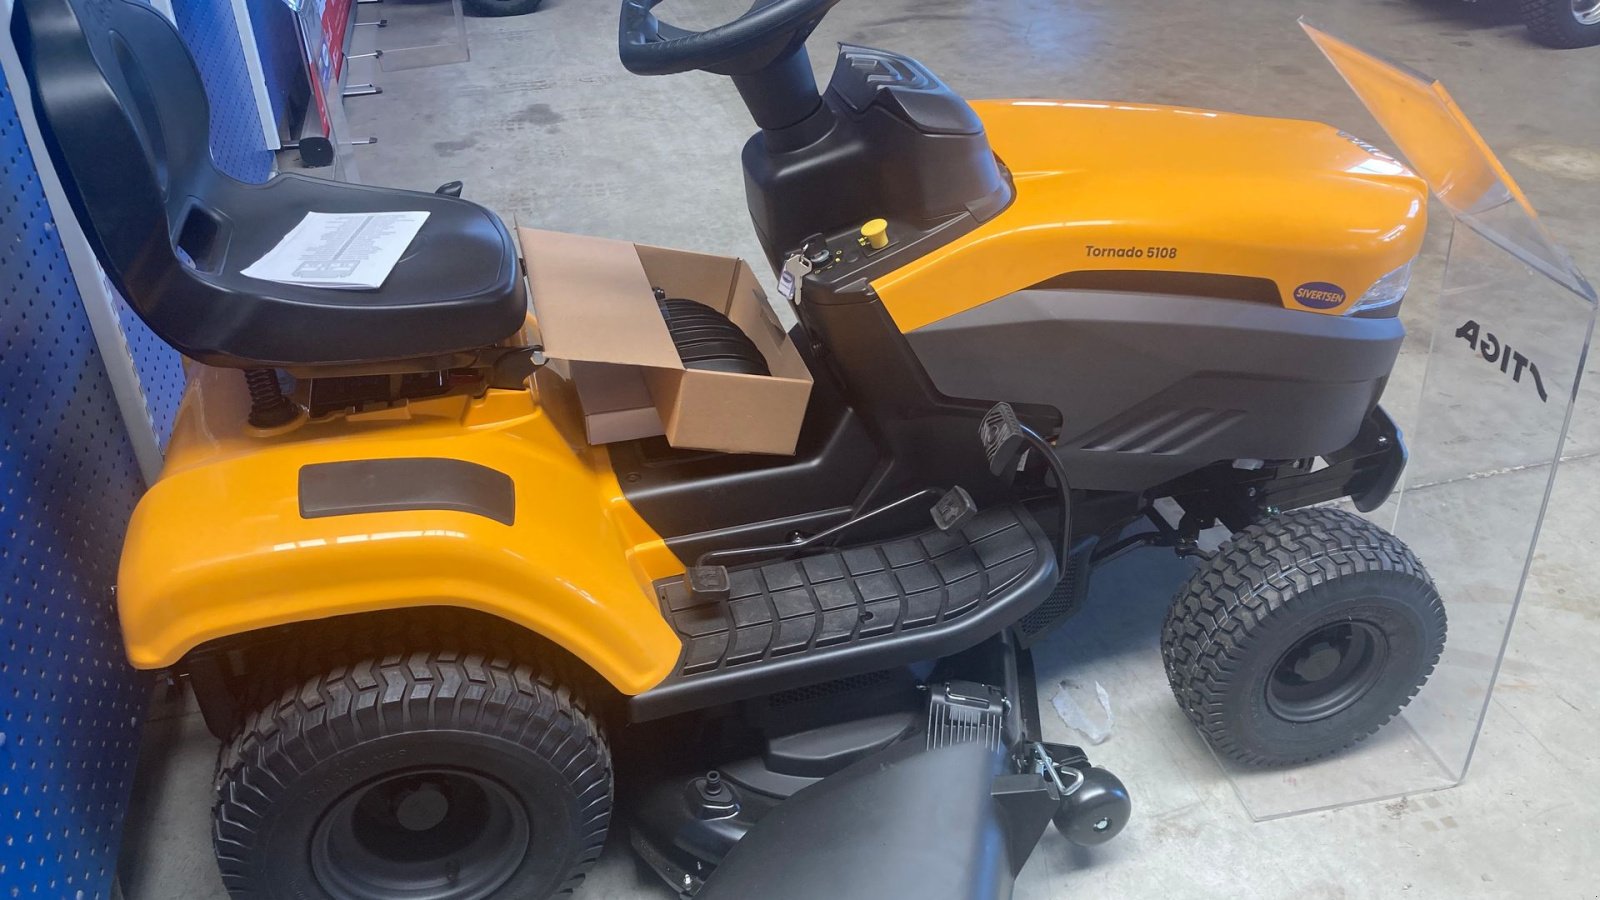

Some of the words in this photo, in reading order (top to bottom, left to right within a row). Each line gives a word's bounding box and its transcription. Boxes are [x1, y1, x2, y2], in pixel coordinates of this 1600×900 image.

[1085, 245, 1143, 258] Tornado
[1147, 246, 1178, 259] 5108
[1296, 287, 1344, 303] SIVERTSEN
